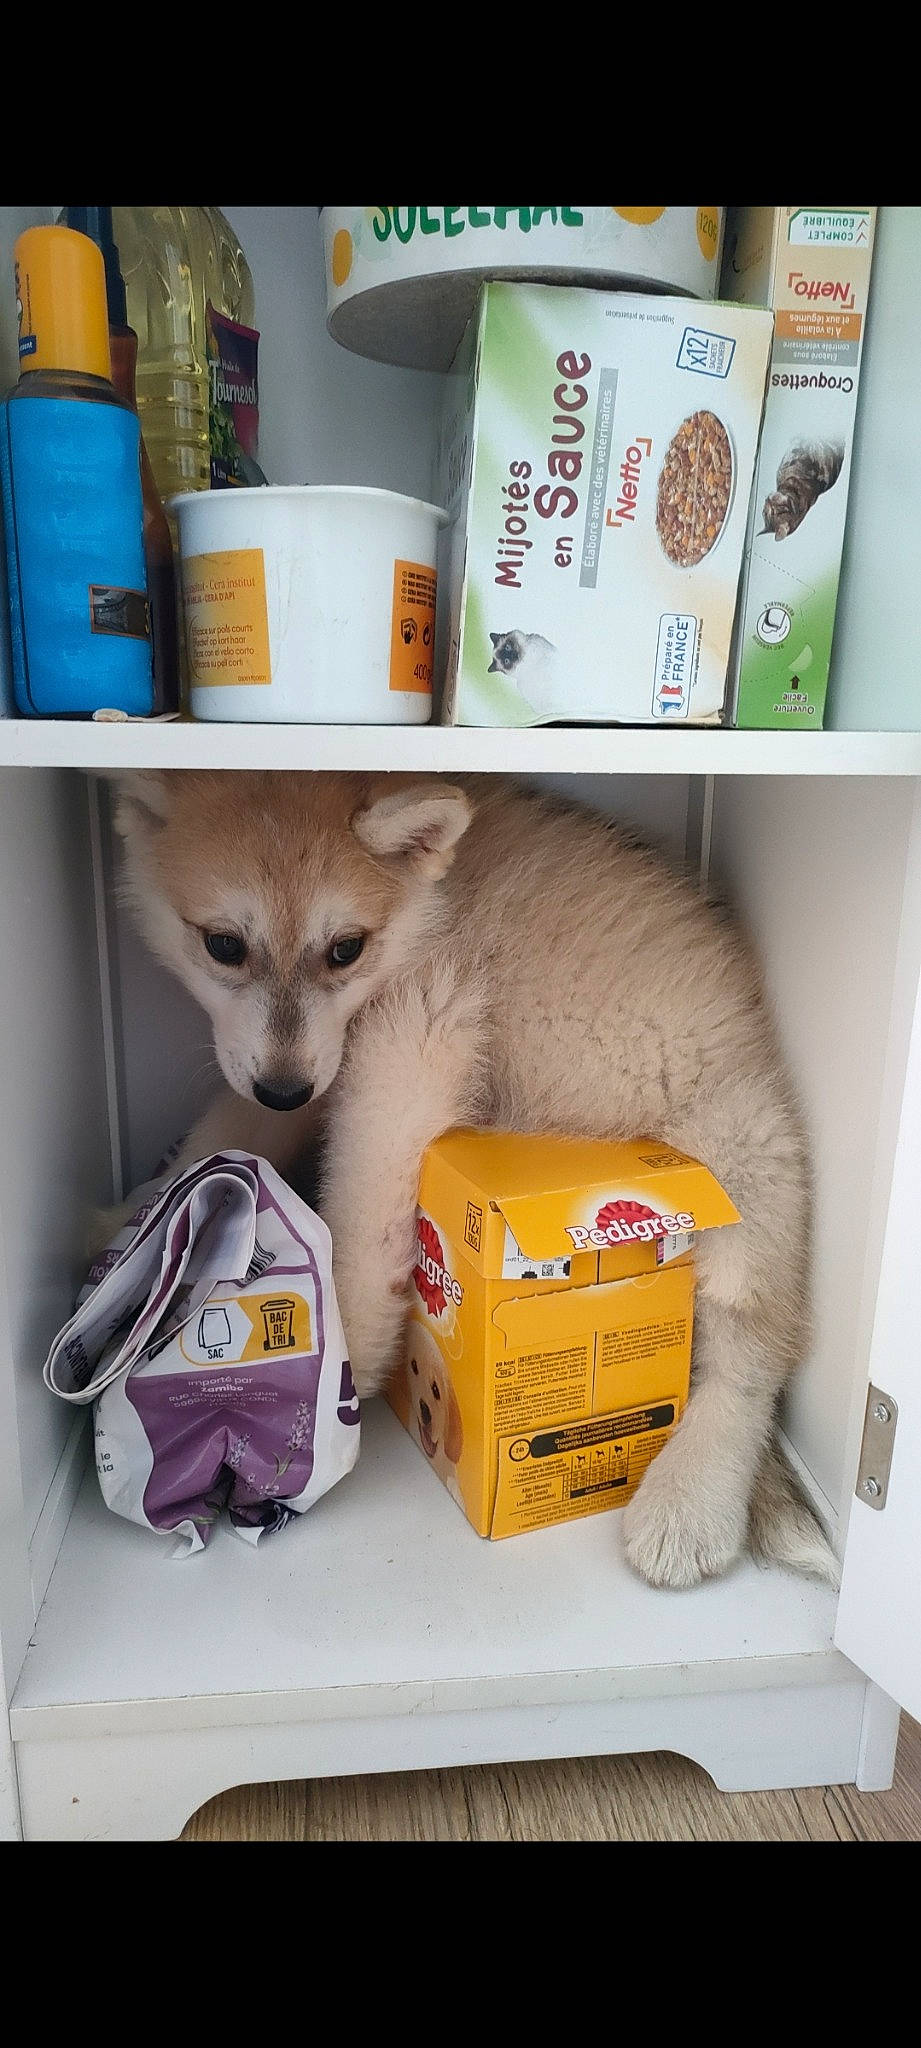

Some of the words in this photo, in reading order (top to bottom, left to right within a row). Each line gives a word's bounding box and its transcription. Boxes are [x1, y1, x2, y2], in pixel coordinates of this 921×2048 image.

[802, 216, 855, 228] ÉQUILIBRÉ
[808, 230, 853, 242] COMPLET
[794, 280, 851, 301] Netto
[789, 314, 825, 324] légumes
[825, 316, 840, 324] aux
[842, 316, 850, 324] et
[796, 325, 825, 335] volaille
[827, 326, 835, 335] la
[686, 337, 709, 367] x12
[209, 360, 257, 405] Tournesol
[771, 371, 853, 393] Croquettes
[595, 389, 612, 465] vétérinaires
[533, 350, 592, 519] Sauce
[593, 465, 605, 487] des
[615, 446, 642, 521] Netto
[591, 488, 603, 519] avec
[494, 460, 533, 588] Mijotés
[583, 521, 600, 568] Élaboré
[554, 536, 573, 568] en
[227, 577, 256, 589] institut
[231, 624, 254, 633] courts
[235, 647, 255, 656] corto
[661, 640, 673, 681] Préparé
[667, 625, 674, 638] en
[783, 692, 808, 702] Facile
[773, 704, 815, 715] Ouverture
[565, 1212, 696, 1250] Pedigree
[269, 1311, 287, 1323] BAC
[273, 1323, 285, 1335] DE
[271, 1334, 286, 1346] TRI
[207, 1348, 224, 1359] SAC
[234, 1376, 255, 1386] par
[103, 1464, 114, 1473] la
